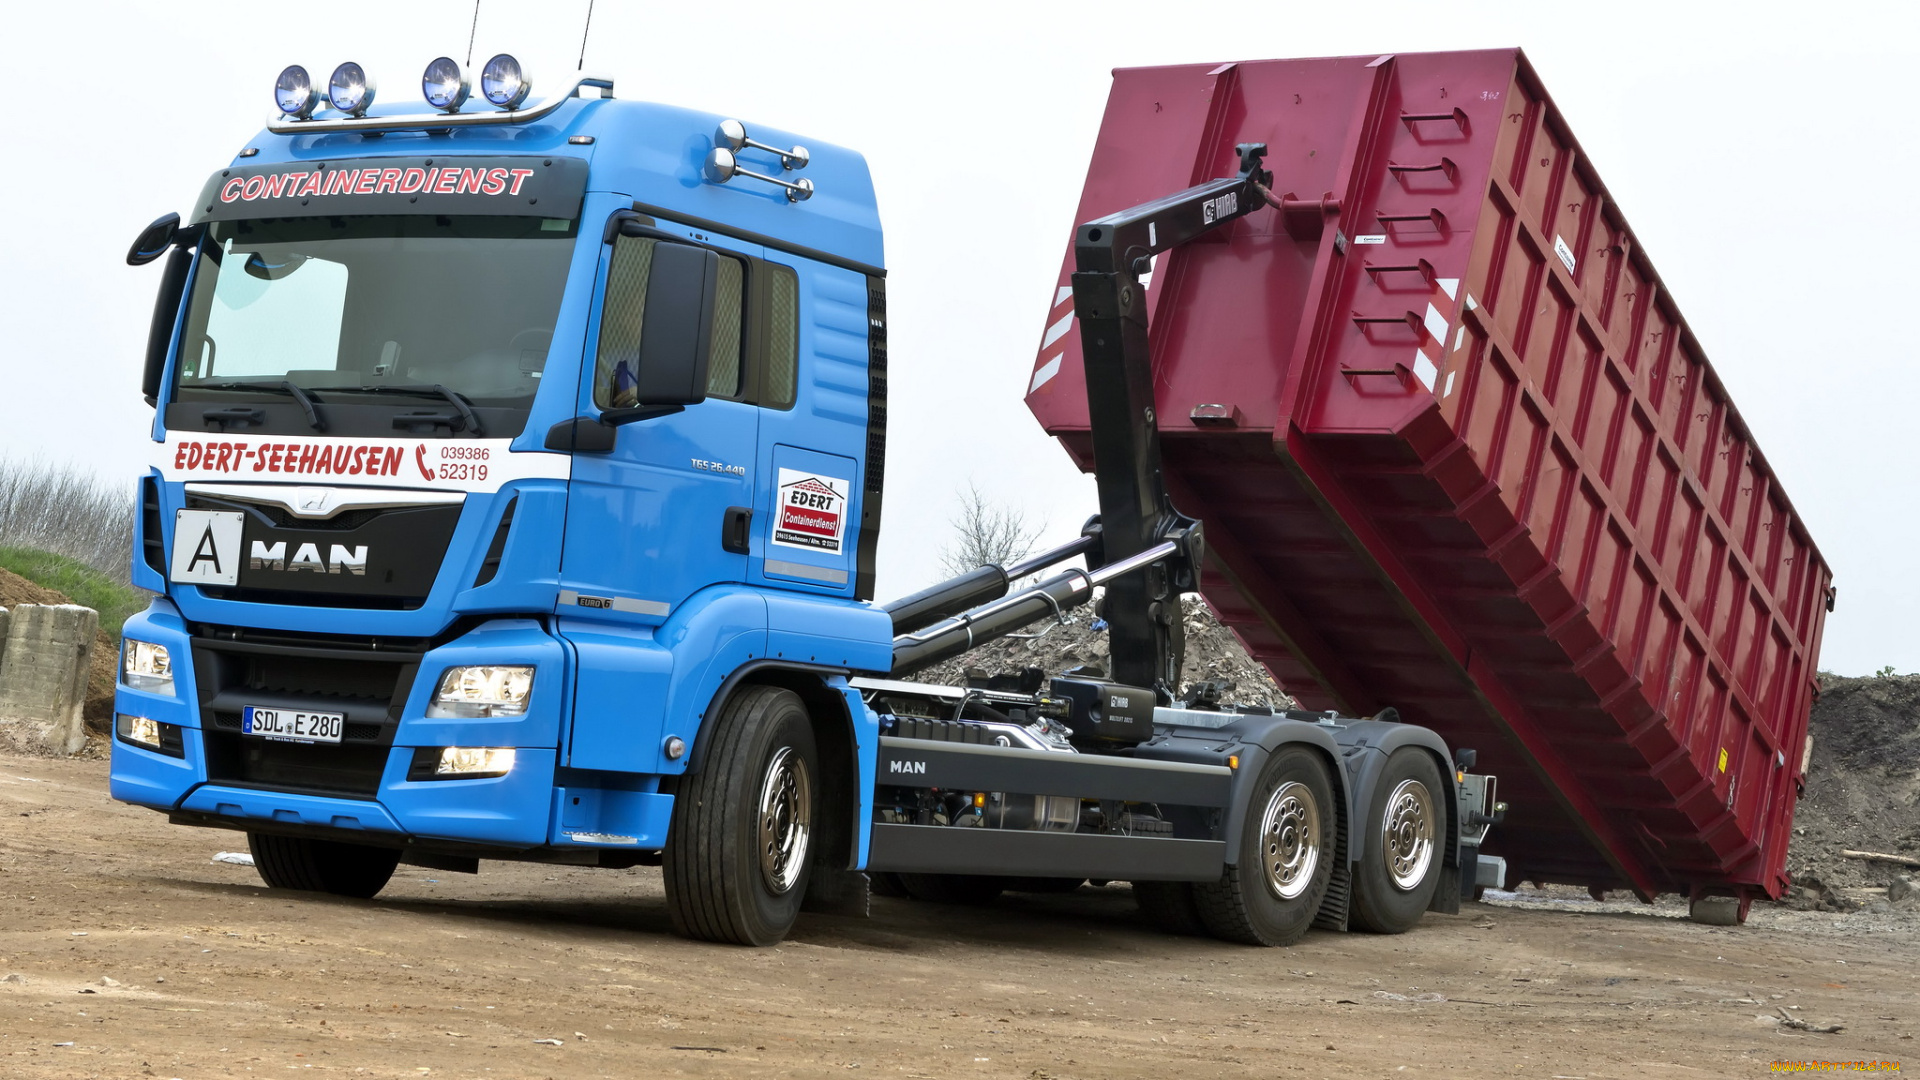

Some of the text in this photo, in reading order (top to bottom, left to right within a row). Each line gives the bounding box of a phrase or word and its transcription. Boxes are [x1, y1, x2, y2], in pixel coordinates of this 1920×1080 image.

[220, 167, 534, 203] CONTAINERDIENST
[1215, 191, 1238, 220] HIAB
[174, 442, 404, 477] EDERT-SEEHAUSEN
[441, 446, 490, 460] 039386
[439, 463, 489, 481] 52319
[691, 458, 746, 476] TGS 26.440
[791, 490, 834, 510] EDERT
[785, 512, 836, 530] Containerdienst
[187, 519, 222, 574] A
[250, 540, 369, 576] MAN
[580, 598, 601, 608] EURO
[253, 710, 340, 738] SDL E 280
[890, 760, 926, 774] MAN
